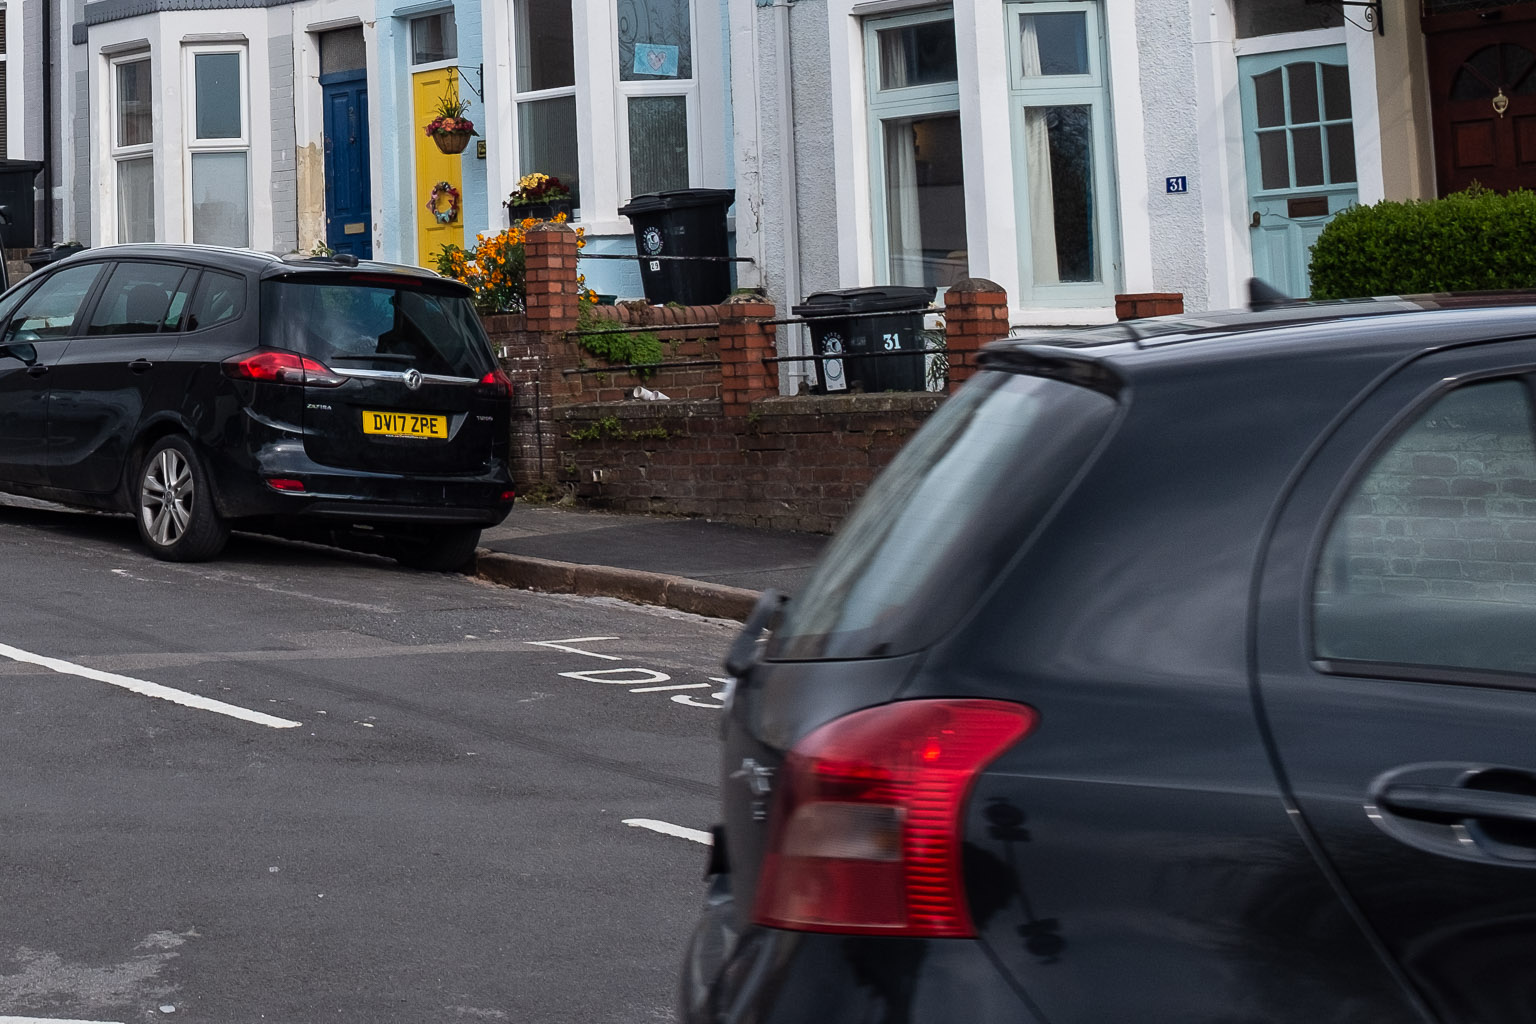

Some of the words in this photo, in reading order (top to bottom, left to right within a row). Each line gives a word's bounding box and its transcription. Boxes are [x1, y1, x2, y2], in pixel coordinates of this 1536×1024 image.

[1169, 178, 1184, 192] 31
[650, 261, 660, 271] 29
[882, 332, 902, 351] 31
[373, 413, 406, 433] DV17
[410, 415, 439, 434] ZPE
